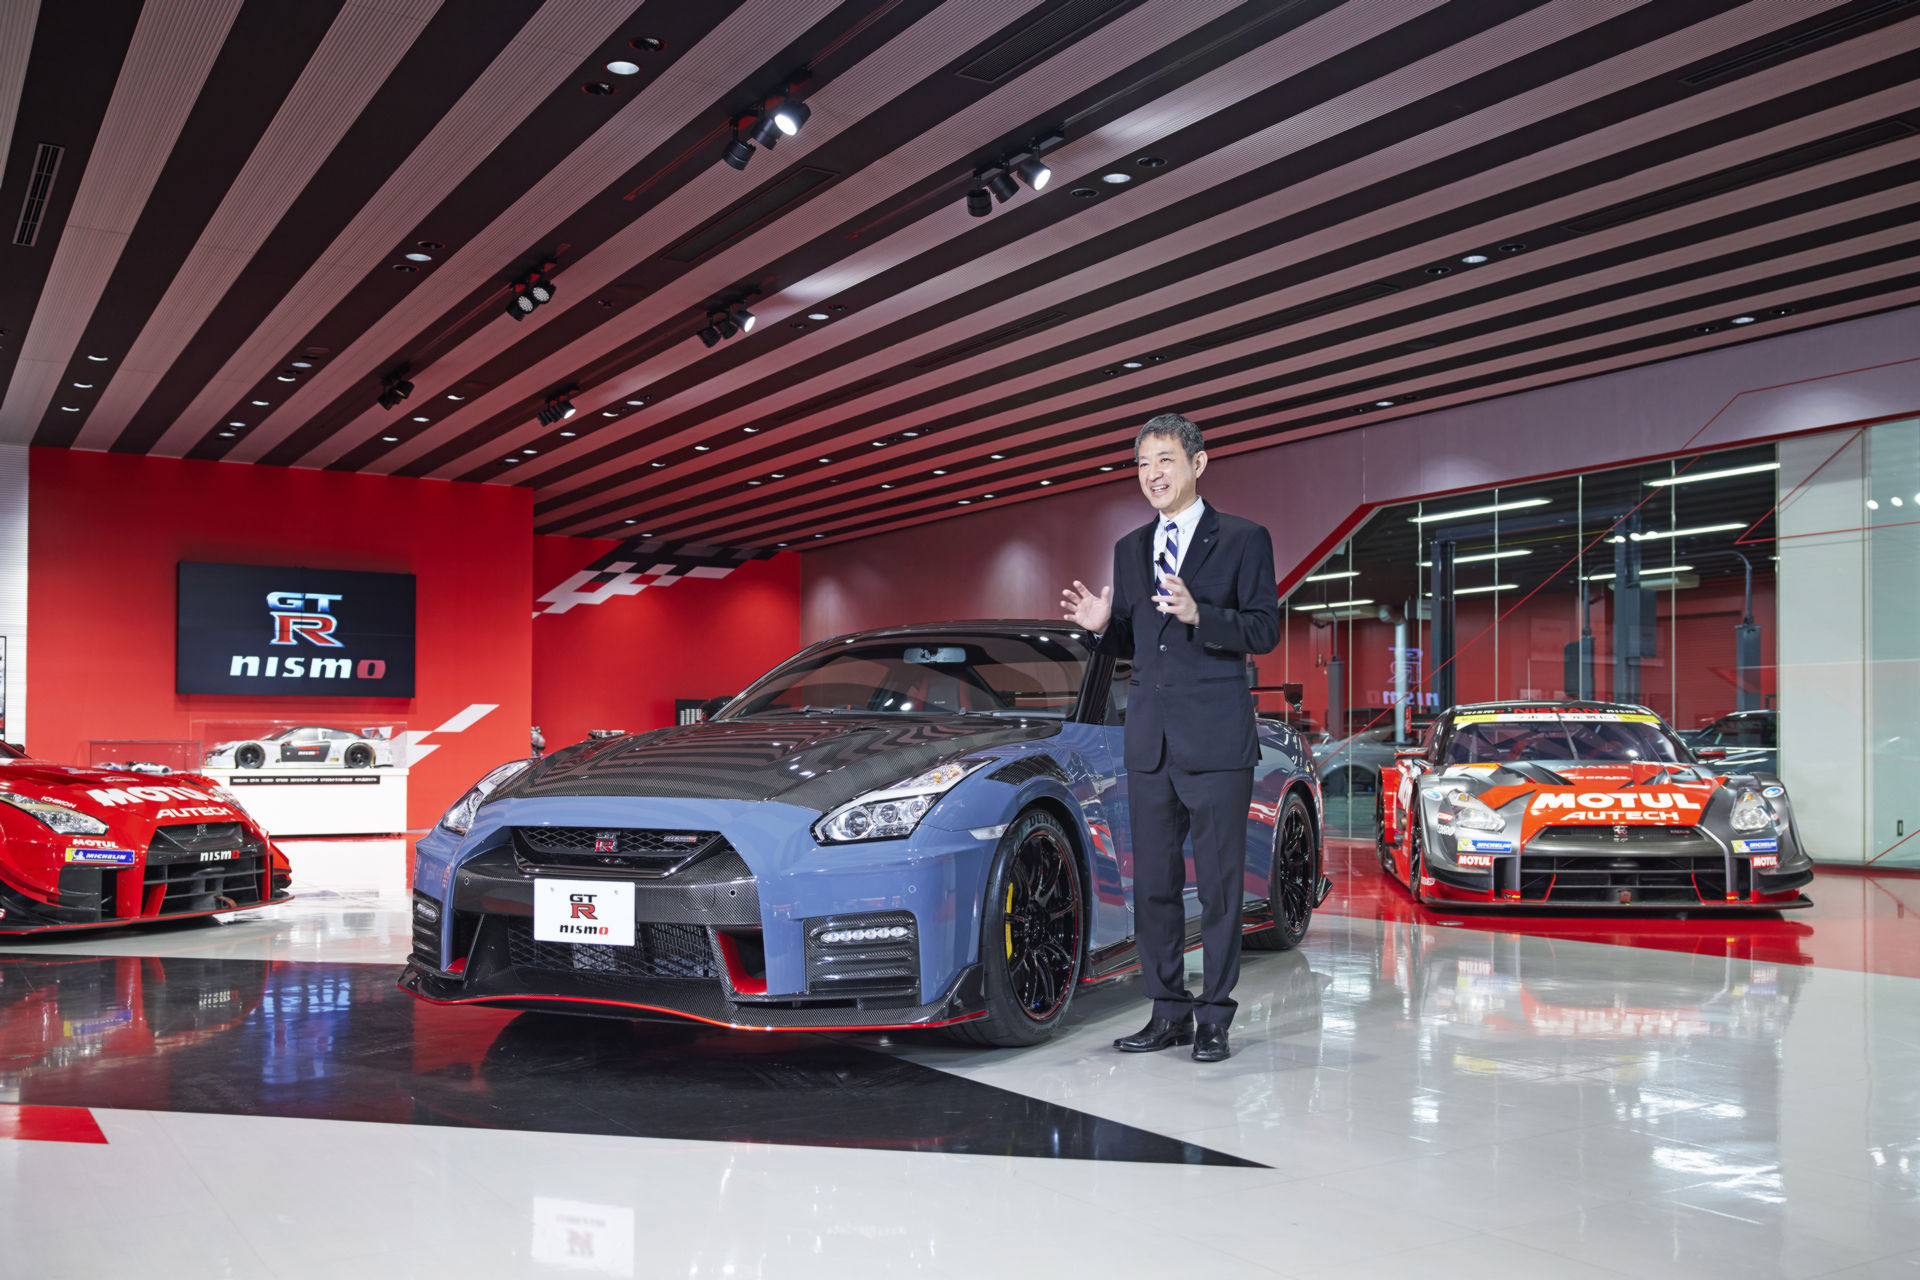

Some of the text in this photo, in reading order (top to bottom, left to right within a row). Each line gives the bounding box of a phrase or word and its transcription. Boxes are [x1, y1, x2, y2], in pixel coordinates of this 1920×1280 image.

[266, 591, 343, 612] GT
[269, 611, 345, 648] R
[229, 655, 386, 680] nismo
[1531, 792, 1701, 809] MOTUL
[156, 806, 234, 819] AUTECH
[1560, 811, 1680, 821] AUTECH
[72, 838, 119, 849] MOTUL
[86, 852, 127, 860] MICHELIN
[200, 850, 240, 862] nismo
[1458, 855, 1491, 866] MOTUL
[1753, 856, 1778, 867] MOTUL
[569, 893, 597, 903] GT
[570, 903, 598, 920] R
[559, 924, 609, 936] nismo
